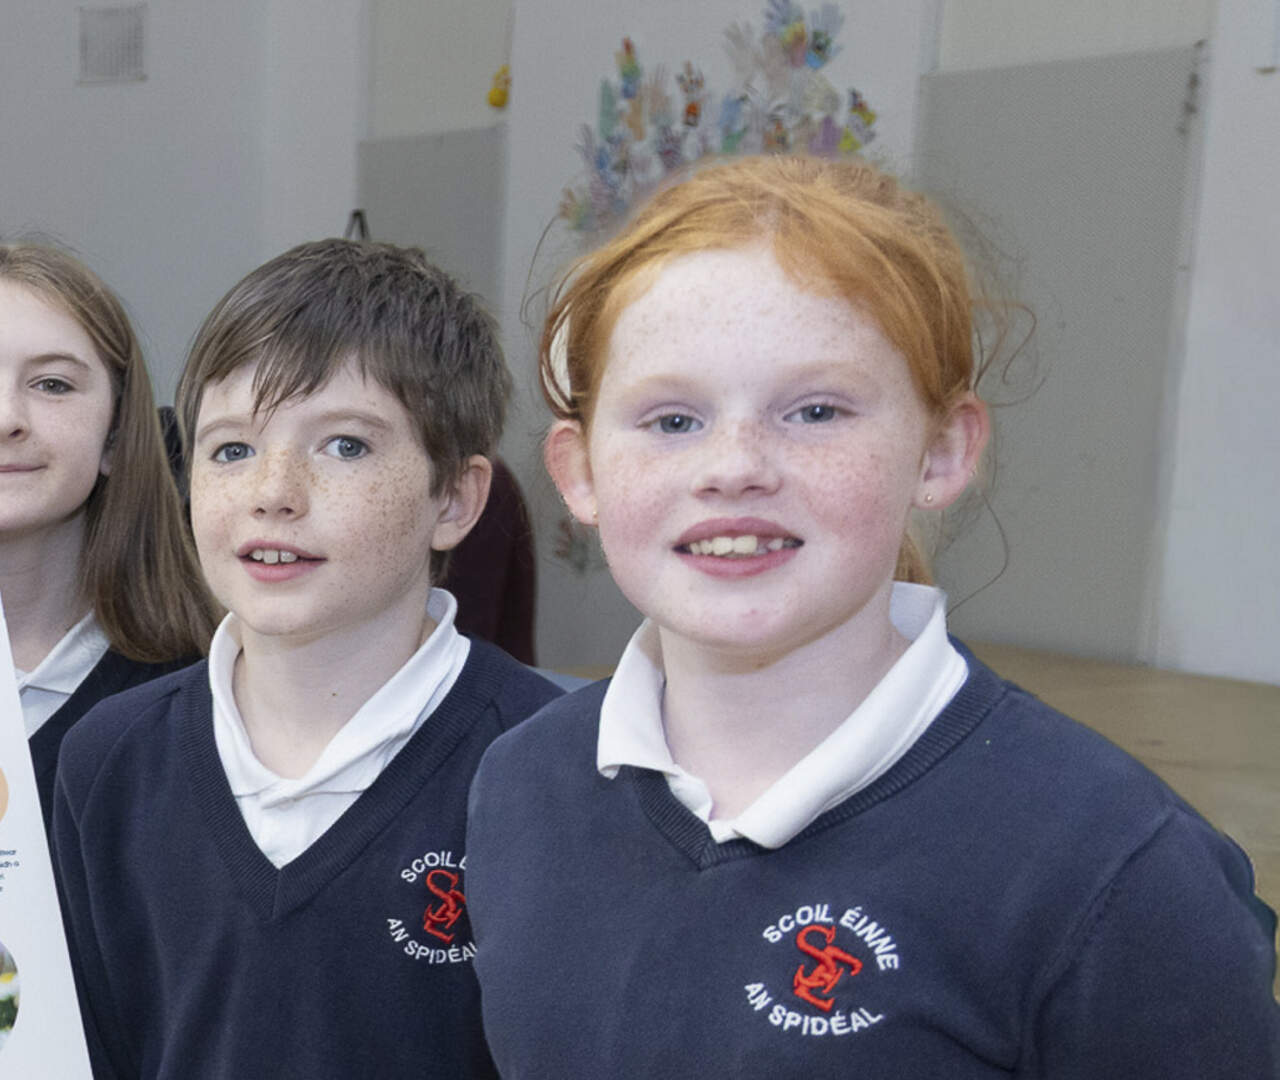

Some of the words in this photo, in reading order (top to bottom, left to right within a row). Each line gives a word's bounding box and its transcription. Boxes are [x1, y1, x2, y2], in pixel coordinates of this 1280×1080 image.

[401, 851, 456, 882] SCOIL
[387, 918, 409, 942] AN
[762, 904, 833, 943] SCOIL
[840, 906, 899, 970] ÉINNE
[744, 982, 772, 1011] AN
[768, 1007, 884, 1036] SPIDÉAL
